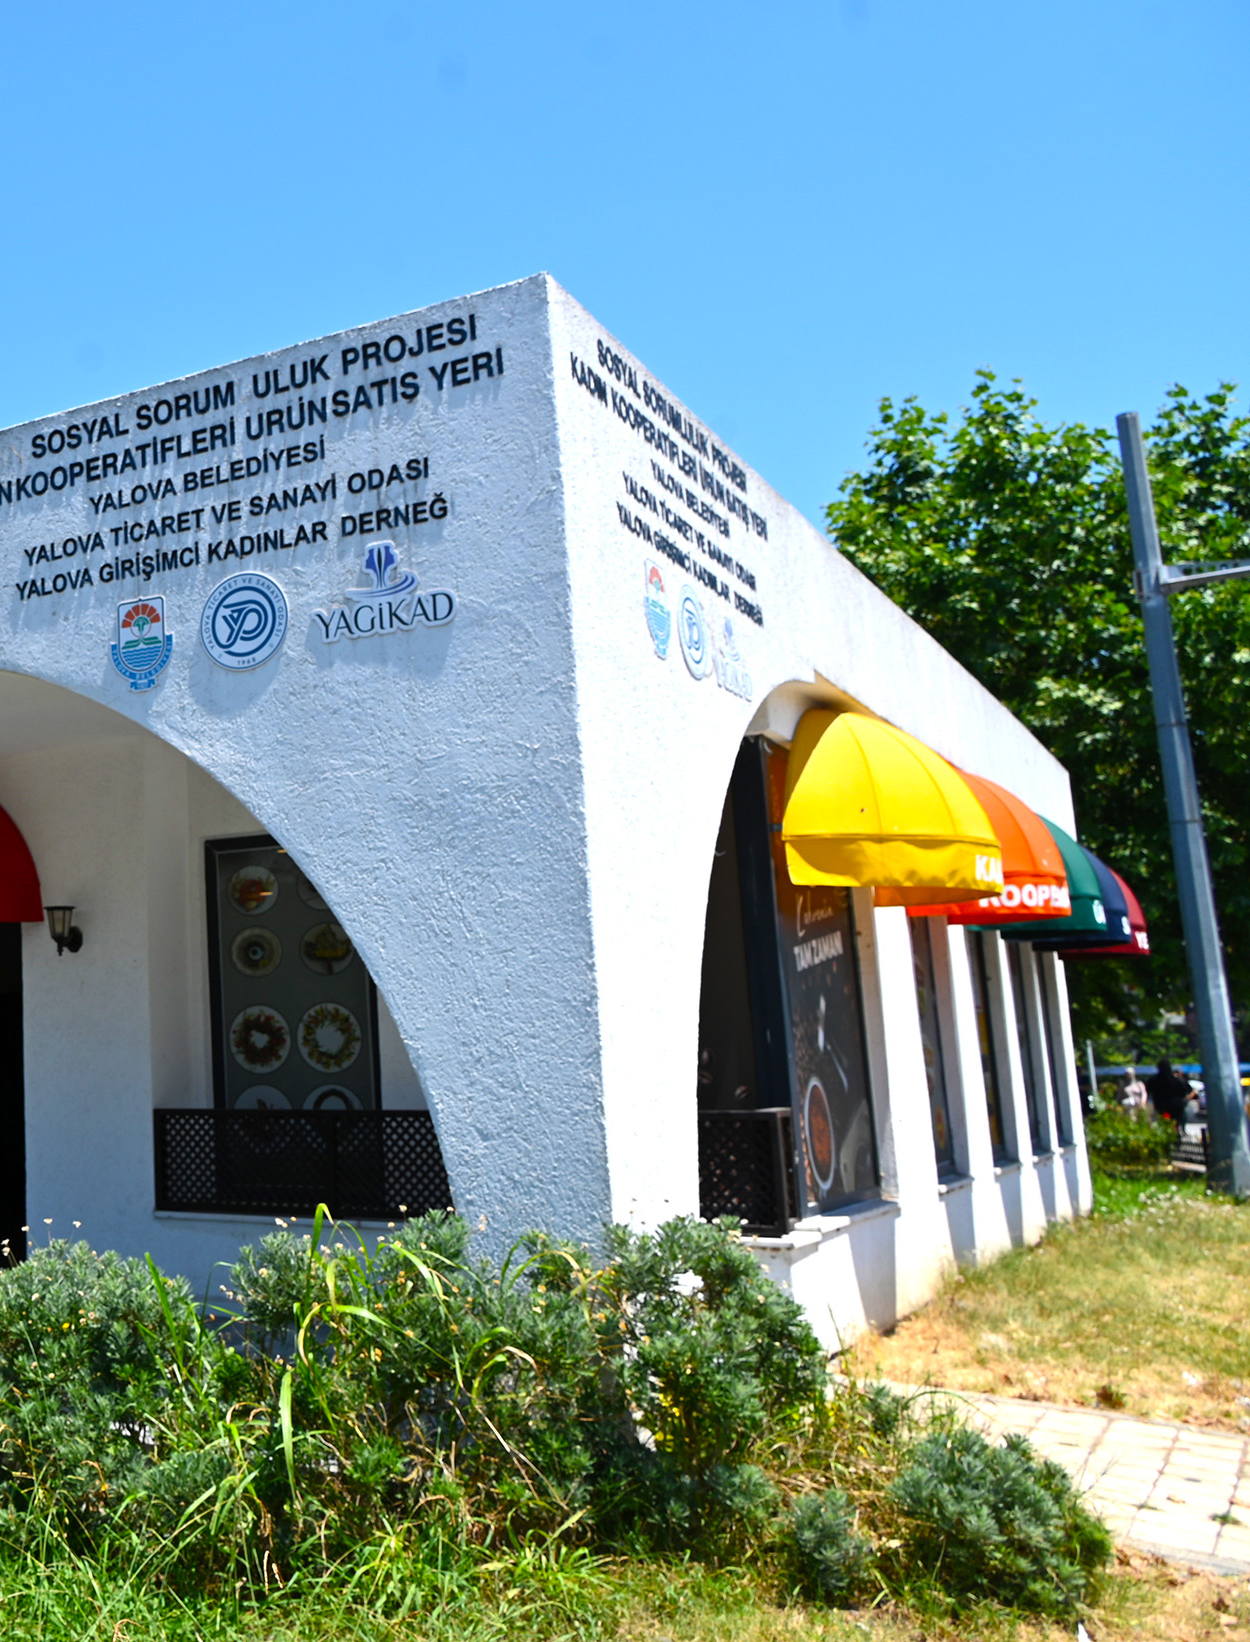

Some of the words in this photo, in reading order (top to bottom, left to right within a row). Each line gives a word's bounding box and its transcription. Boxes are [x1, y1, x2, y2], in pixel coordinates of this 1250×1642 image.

[31, 413, 129, 459] SOSYAL
[136, 381, 235, 430] SORUM
[252, 354, 331, 399] ULUK
[570, 351, 608, 408] KADIN
[597, 339, 641, 400] SOSYAL
[16, 416, 235, 501] KOOPERATİFLERİ
[89, 478, 177, 515] YALOVA
[183, 435, 325, 494] BELEDİYESİ
[622, 471, 659, 517] YALOVA
[15, 568, 94, 601] YALOVA
[100, 541, 200, 582] GİRİŞİMCİ
[207, 521, 328, 564] KADINLAR
[341, 492, 448, 538] DERNEĞ
[24, 532, 105, 567] YALOVA
[110, 507, 204, 547] TİCARET
[211, 500, 242, 525] VE
[249, 473, 338, 517] SANAYİ
[347, 457, 430, 495] ODASI
[616, 501, 653, 547] YALOVA
